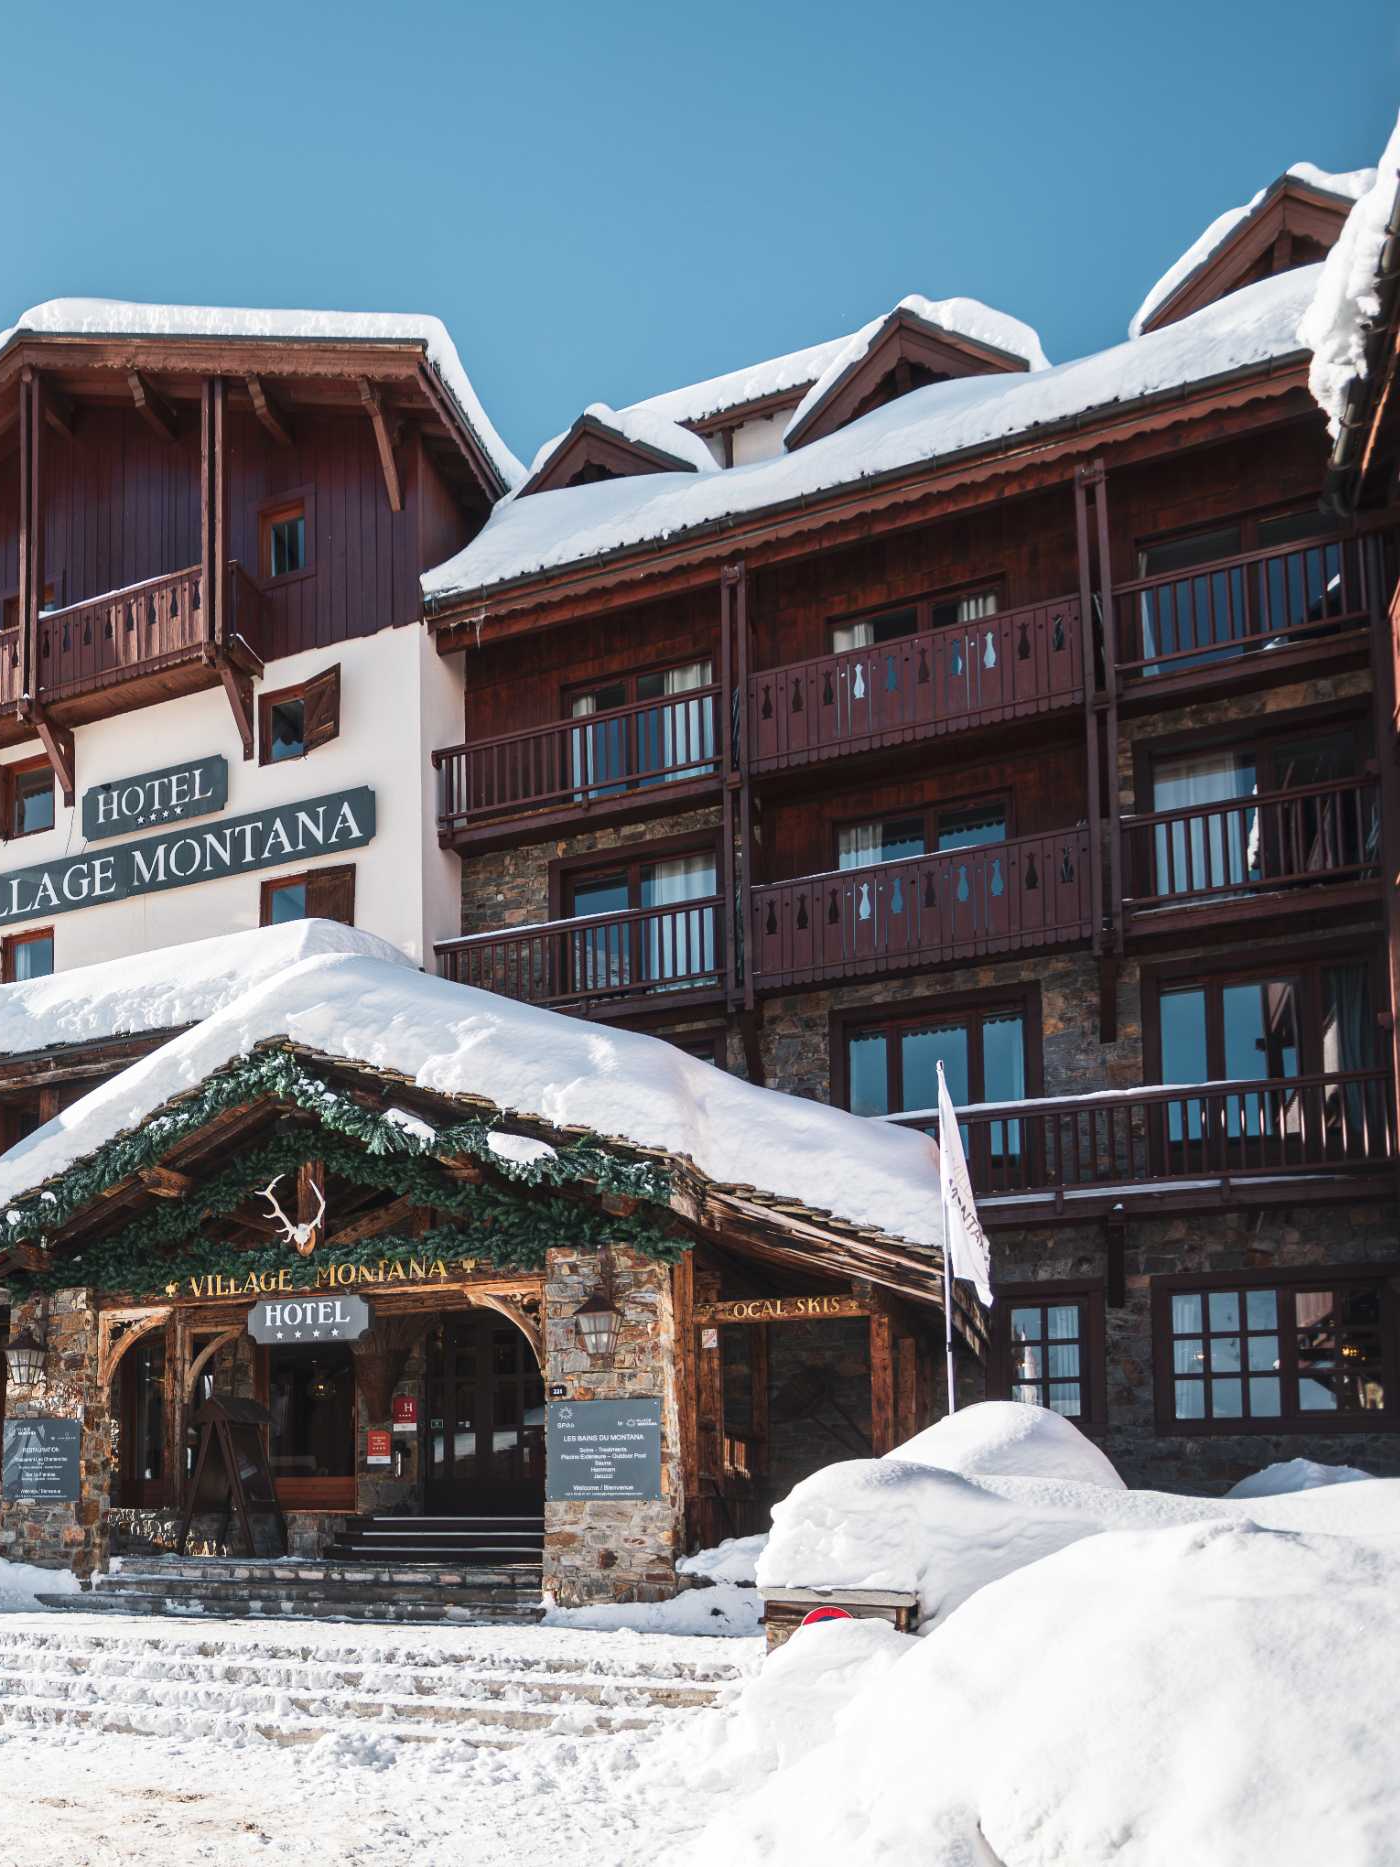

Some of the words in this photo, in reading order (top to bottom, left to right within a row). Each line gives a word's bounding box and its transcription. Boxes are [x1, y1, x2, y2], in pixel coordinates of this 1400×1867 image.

[96, 769, 213, 824] HOTEL
[131, 800, 363, 886] MONTANA
[188, 1268, 293, 1297] VILLAGE
[315, 1256, 449, 1288] MONTANA
[264, 1301, 350, 1326] HOTEL
[795, 1297, 840, 1314] SKIS
[404, 1402, 413, 1412] H
